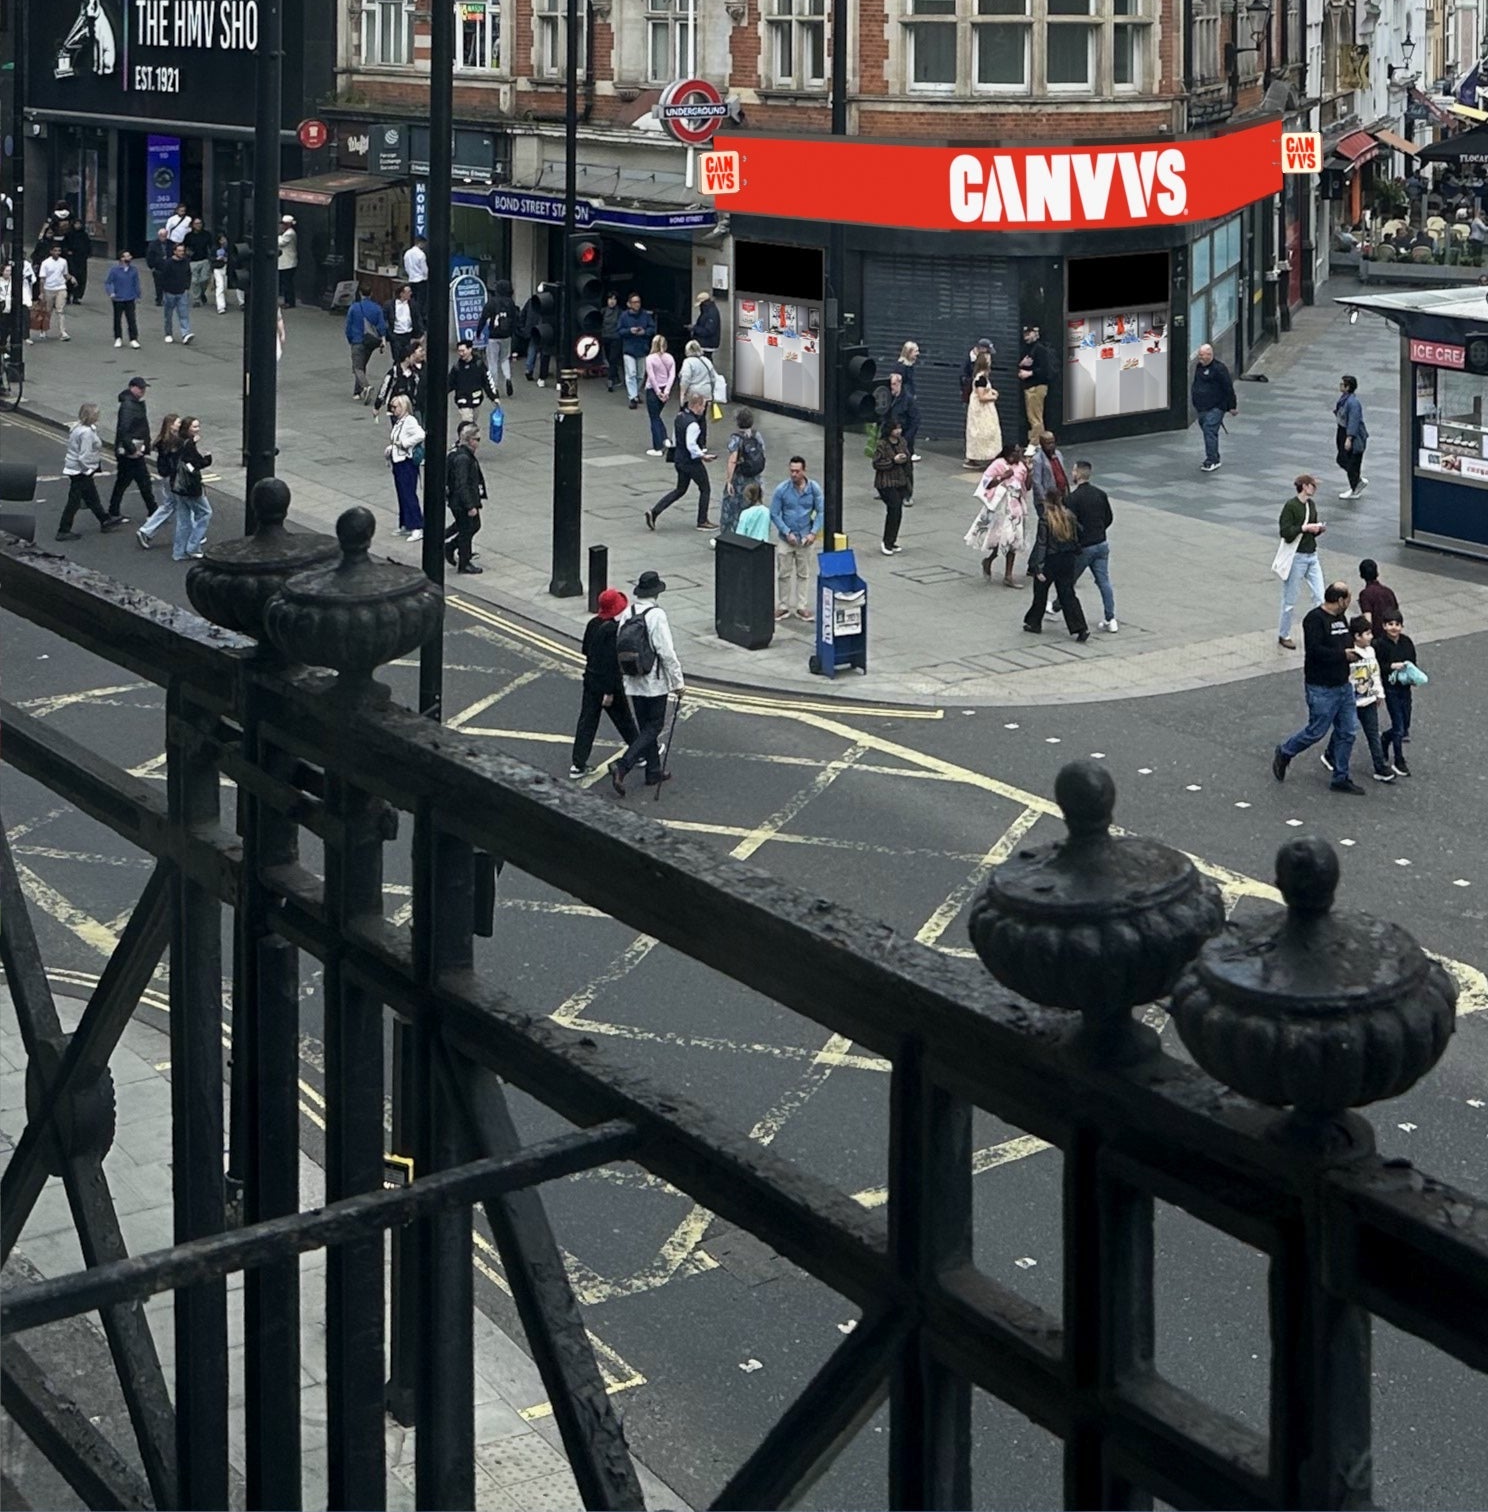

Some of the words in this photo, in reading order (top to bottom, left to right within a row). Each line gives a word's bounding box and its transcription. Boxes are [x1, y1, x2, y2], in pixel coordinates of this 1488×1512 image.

[136, 0, 169, 47] THE
[174, 0, 215, 48] HMV
[220, 0, 258, 50] SHO
[135, 66, 155, 92] EST.
[156, 68, 179, 92] 1921
[665, 106, 726, 117] UNDERGROUND
[1286, 137, 1315, 153] CAN
[705, 155, 733, 173] CAN
[416, 183, 425, 235] MONEY
[495, 195, 520, 212] BOND
[520, 199, 550, 216] STREET
[552, 203, 589, 221] STAON
[669, 216, 685, 224] BOND
[686, 215, 704, 224] STREET
[451, 264, 480, 279] ATM
[1412, 344, 1434, 360] ICE
